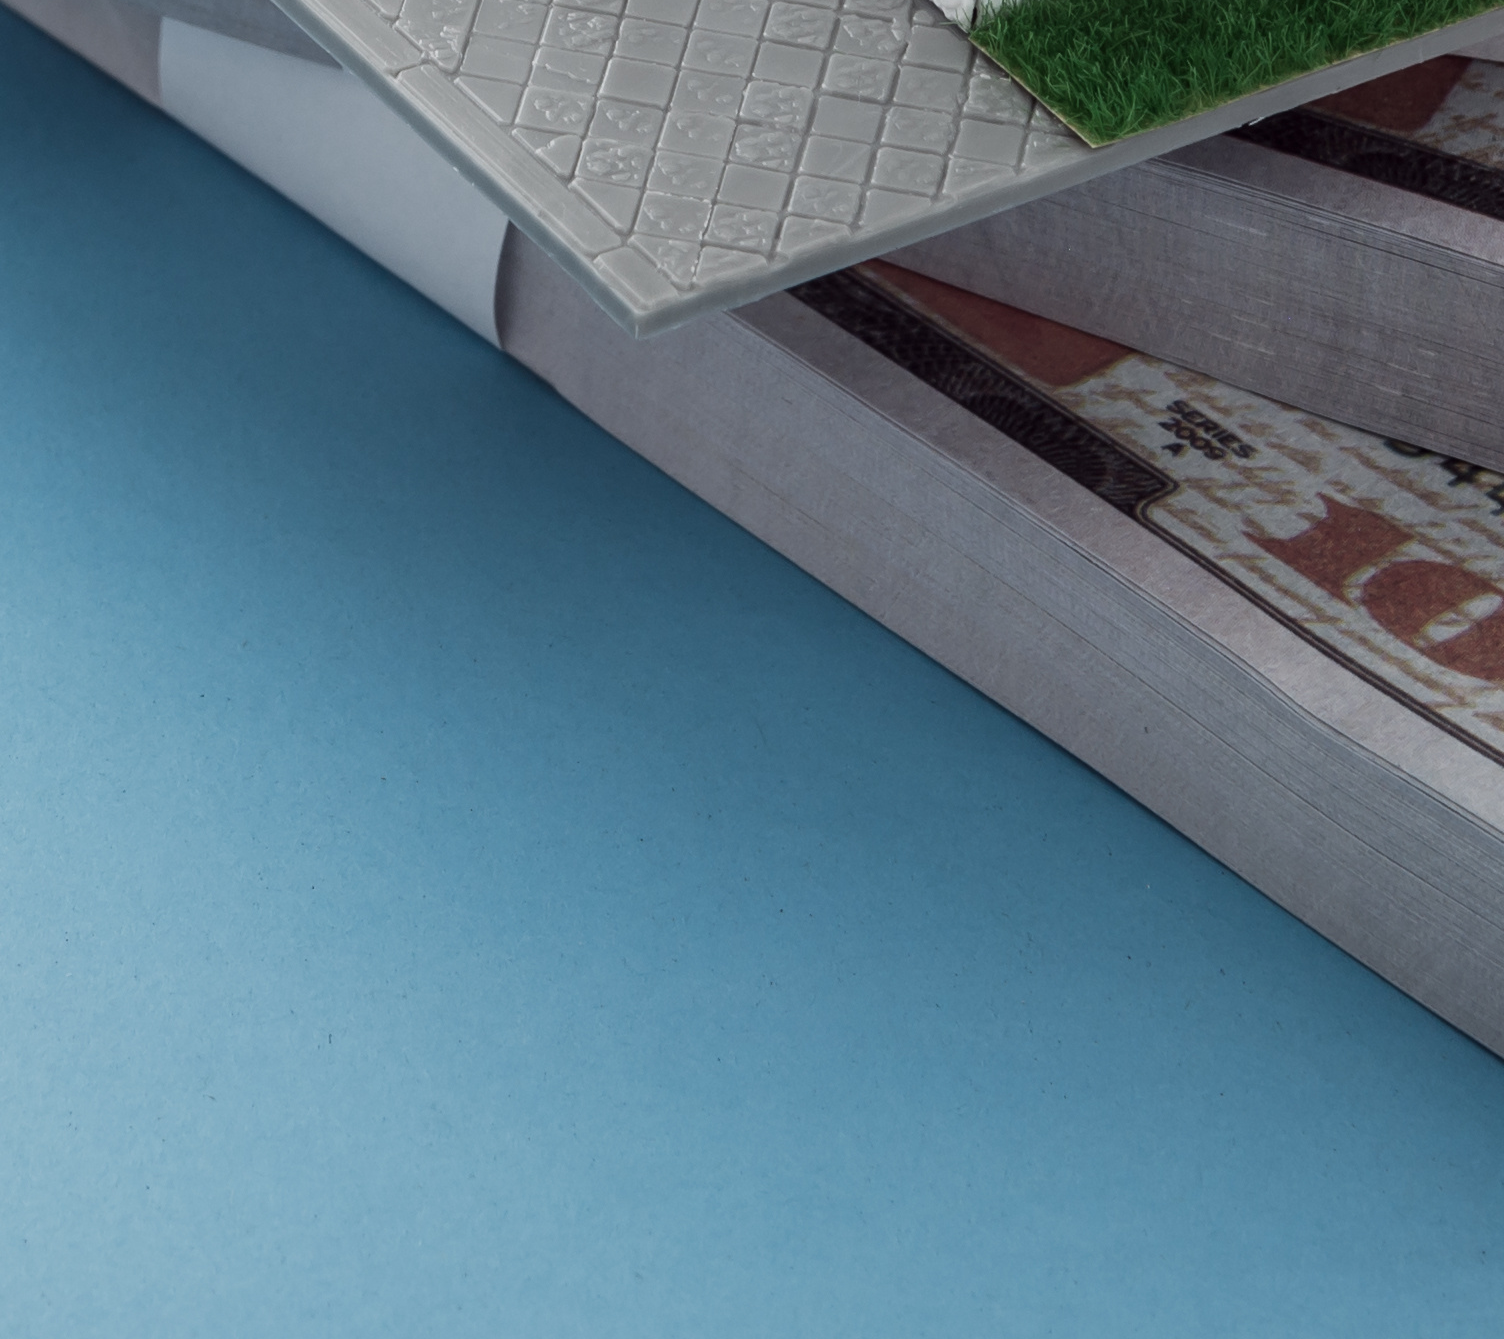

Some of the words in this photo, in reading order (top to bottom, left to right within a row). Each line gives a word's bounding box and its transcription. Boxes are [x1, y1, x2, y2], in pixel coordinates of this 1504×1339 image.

[1157, 417, 1226, 460] 2009
[1160, 442, 1185, 457] A
[1166, 399, 1258, 459] SERIES
